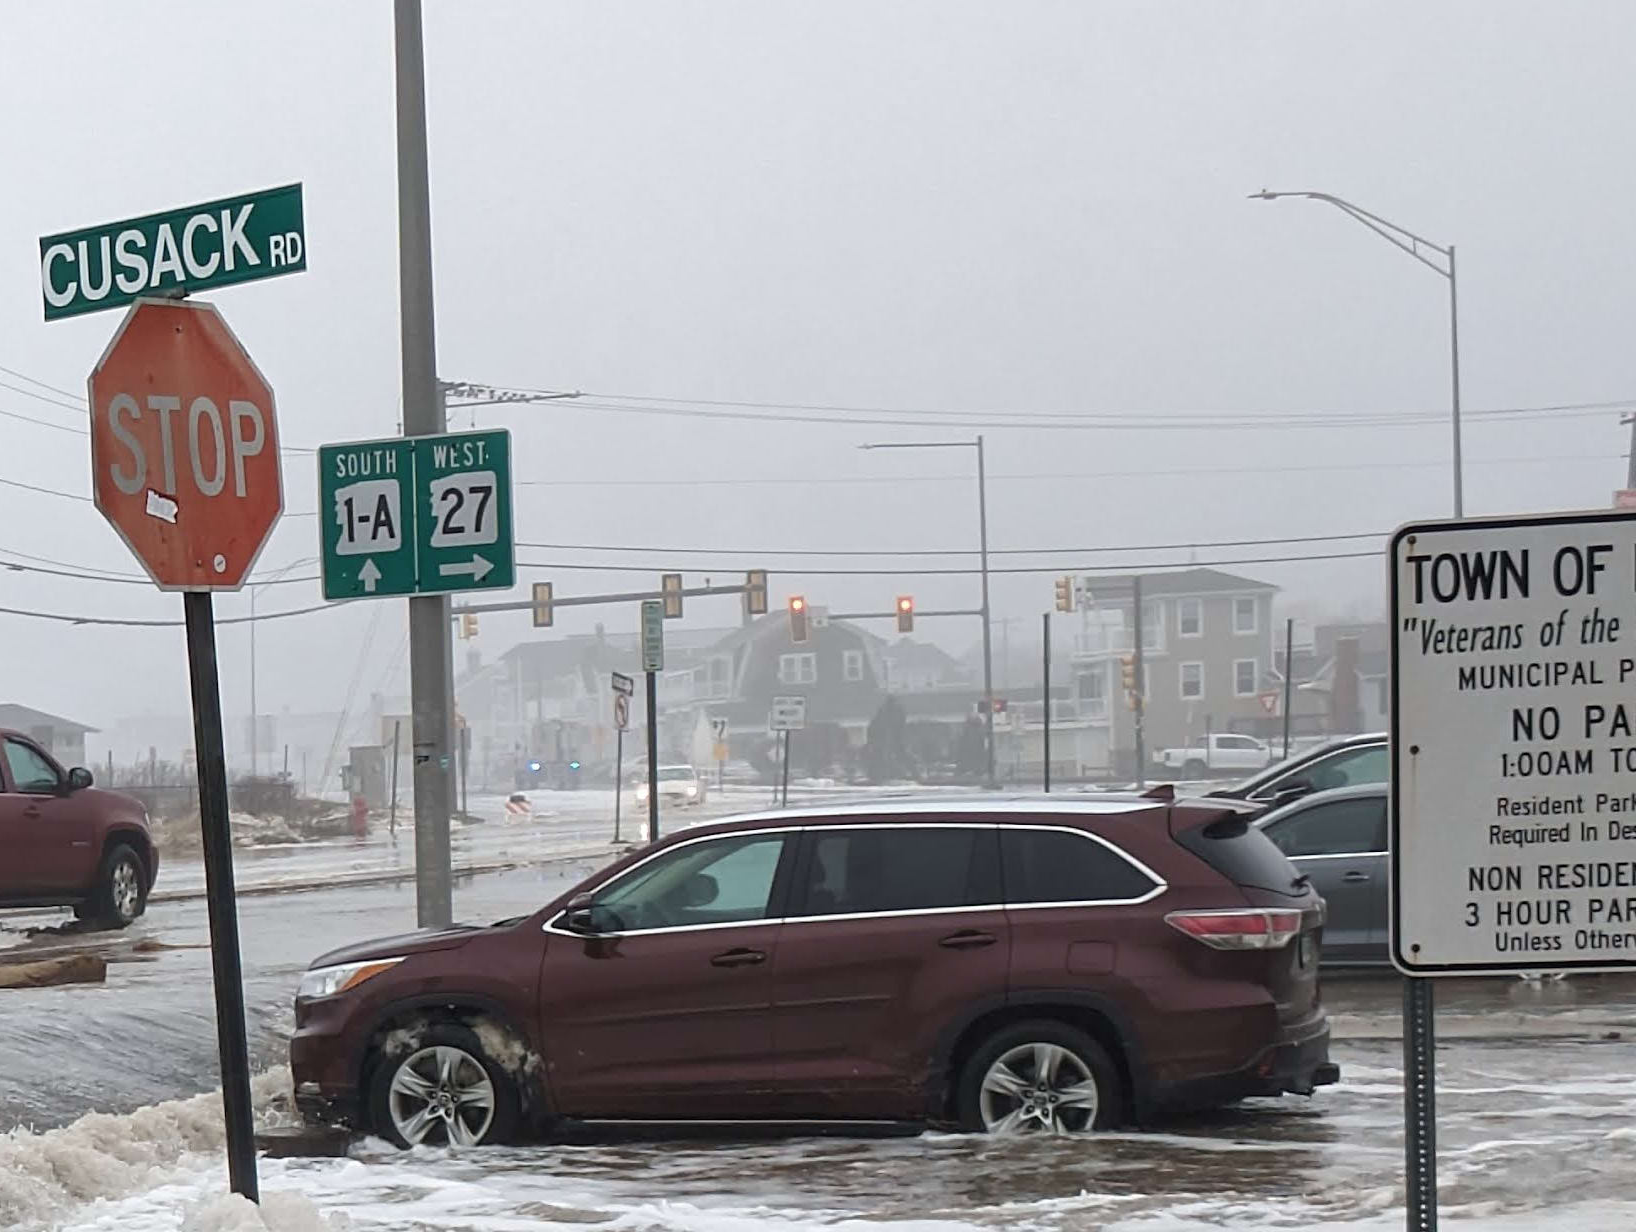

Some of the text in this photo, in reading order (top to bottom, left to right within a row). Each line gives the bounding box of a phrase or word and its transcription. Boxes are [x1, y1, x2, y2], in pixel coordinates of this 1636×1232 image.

[42, 203, 303, 307] CUSACK RD
[109, 393, 265, 497] STOP
[433, 440, 486, 469] WEST
[336, 449, 397, 478] SOUTH
[344, 494, 396, 542] 1-A
[441, 485, 493, 535] 27
[1406, 549, 1529, 603] TOWN
[1553, 544, 1613, 596] OF
[1403, 607, 1620, 655] "Veterans of the
[1458, 658, 1635, 692] MUNICIPAL P
[1513, 703, 1632, 742] NO PA
[1501, 750, 1593, 777] 1:00AM
[1497, 796, 1585, 817] Resident
[1489, 823, 1570, 848] Required
[1580, 822, 1598, 842] In
[1468, 865, 1522, 892] NON
[1465, 897, 1636, 927] 3 HOUR PAR
[1495, 931, 1562, 952] Unless
